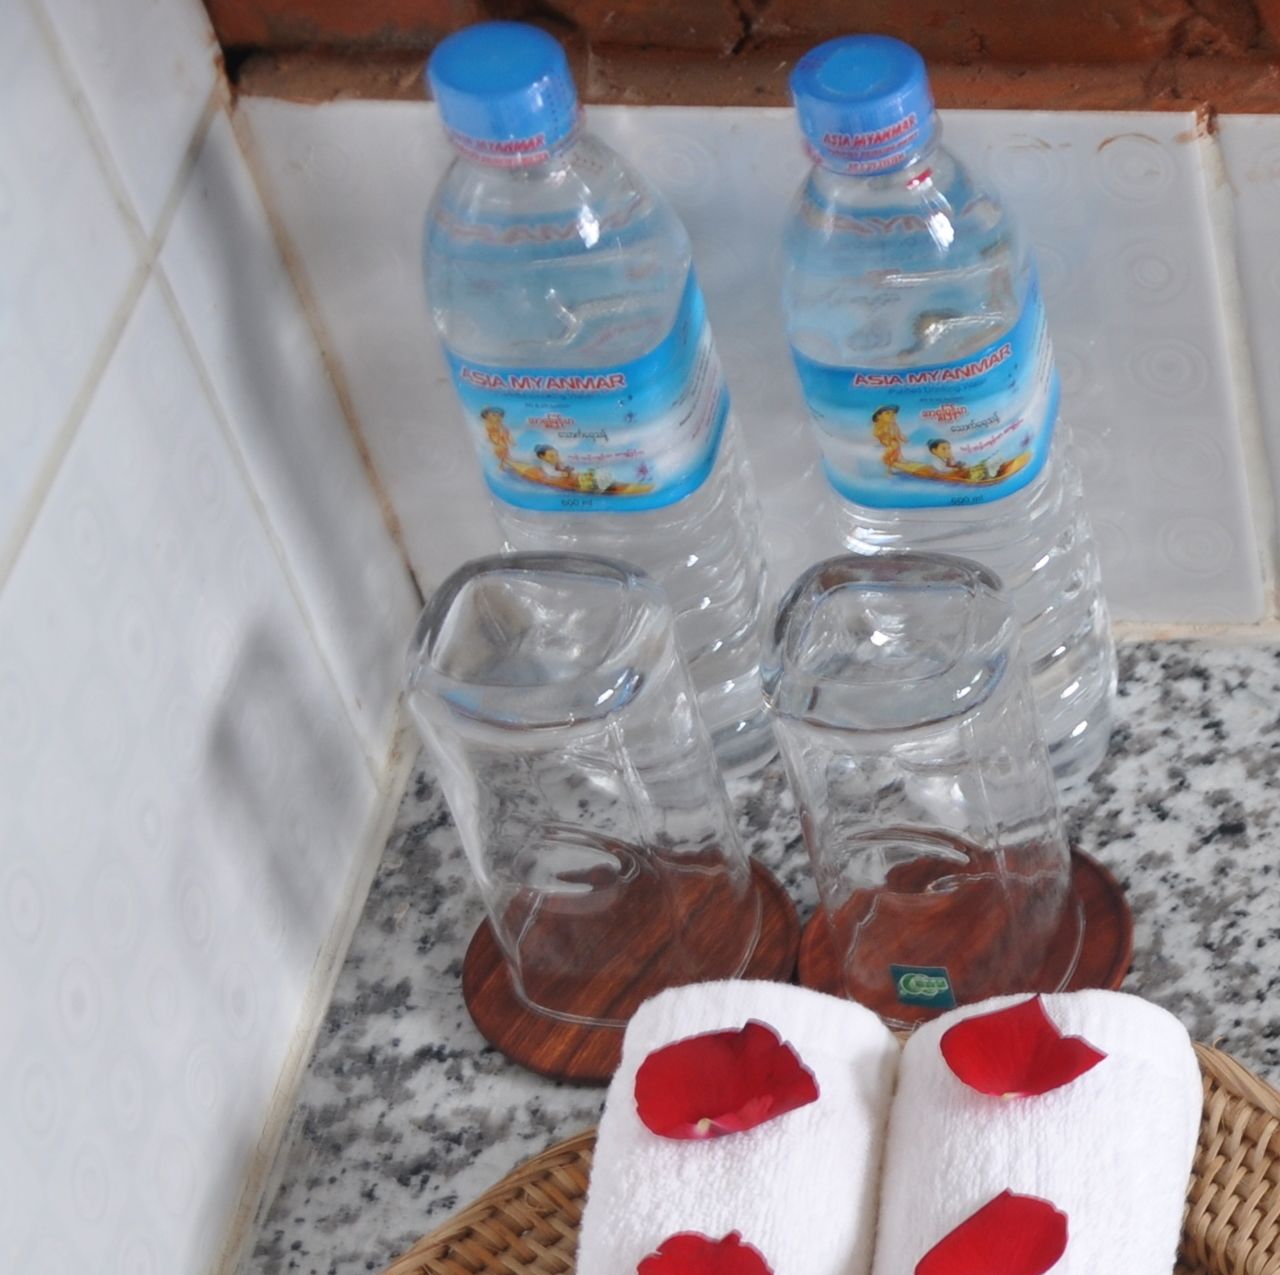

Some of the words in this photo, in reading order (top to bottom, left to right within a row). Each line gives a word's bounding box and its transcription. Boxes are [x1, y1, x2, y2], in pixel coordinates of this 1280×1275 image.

[463, 368, 506, 387] ASIA
[510, 374, 626, 389] MYANMAR
[855, 374, 903, 385] ASIA
[908, 344, 1010, 384] MYANMAR
